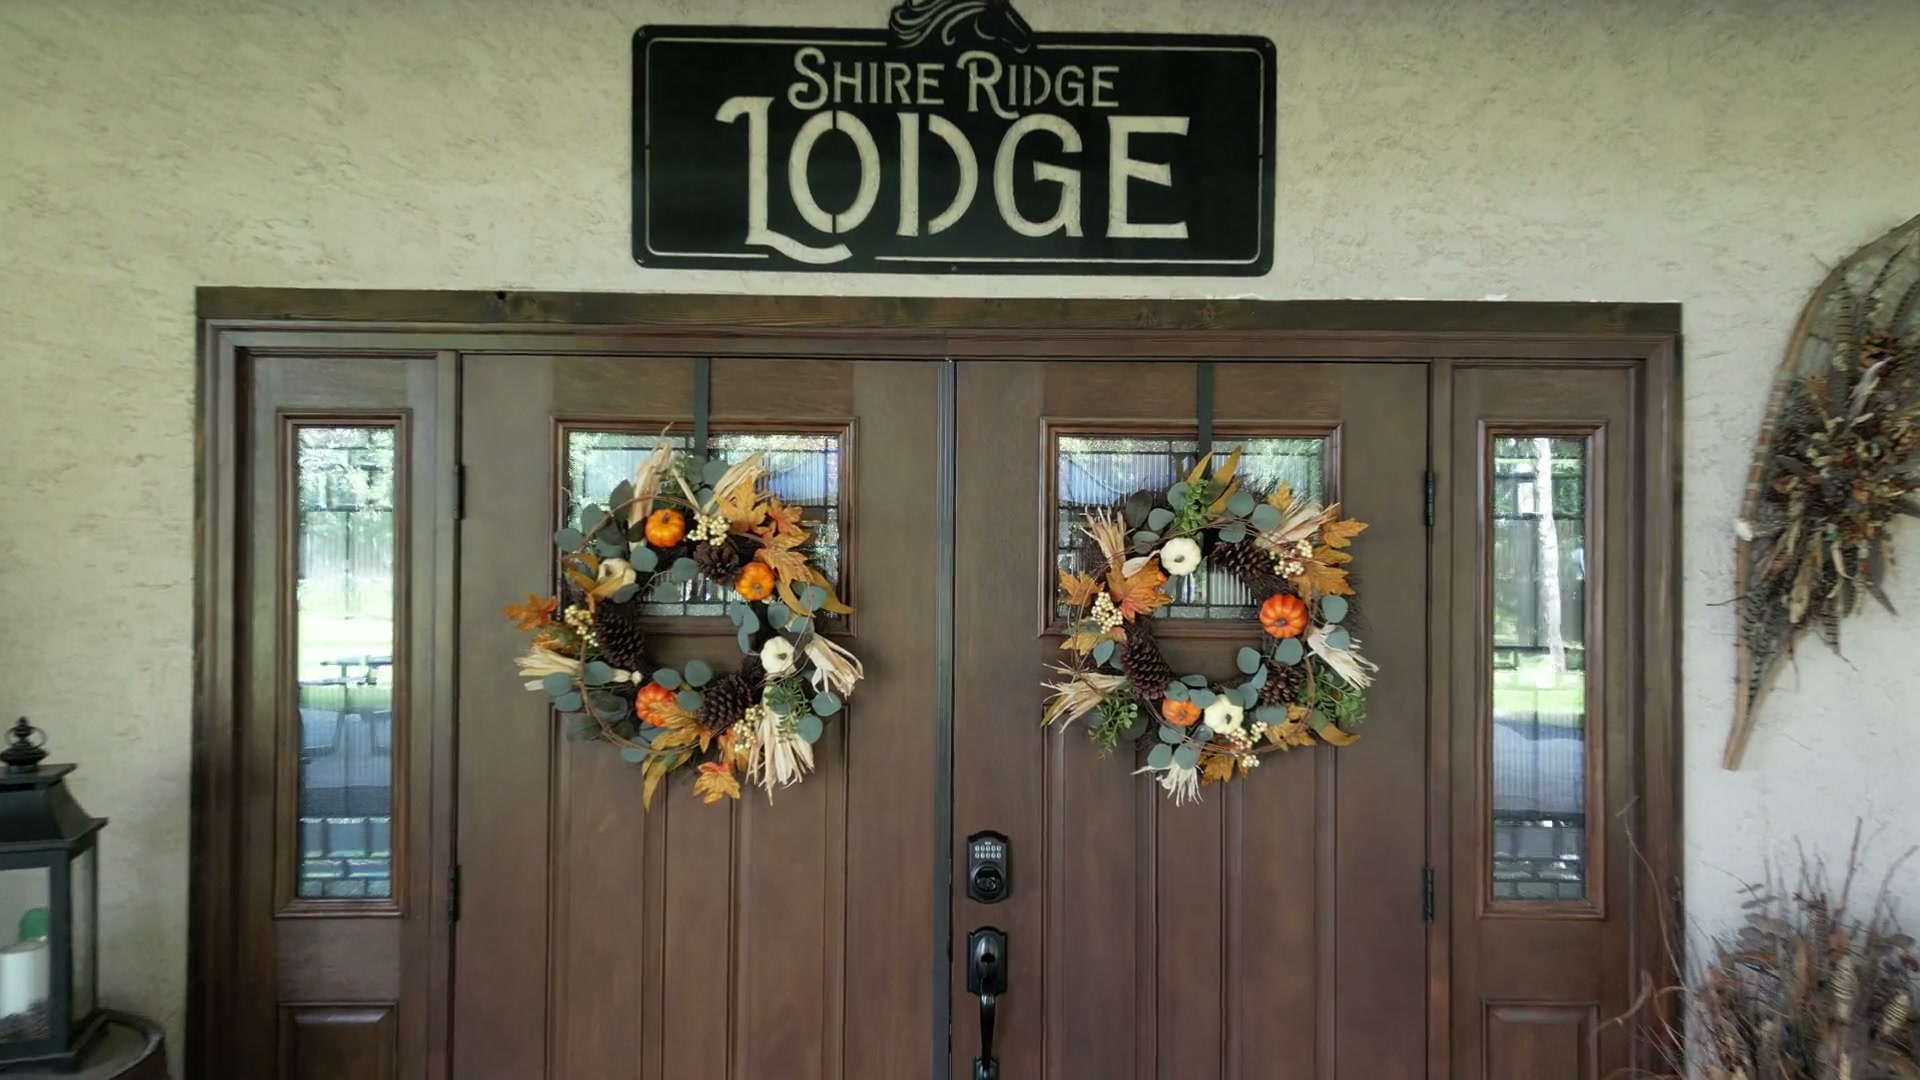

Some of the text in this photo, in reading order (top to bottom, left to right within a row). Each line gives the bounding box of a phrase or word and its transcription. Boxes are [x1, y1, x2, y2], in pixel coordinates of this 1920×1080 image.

[787, 46, 1119, 119] SHIRE RIDGE
[715, 96, 1190, 263] LODGE
